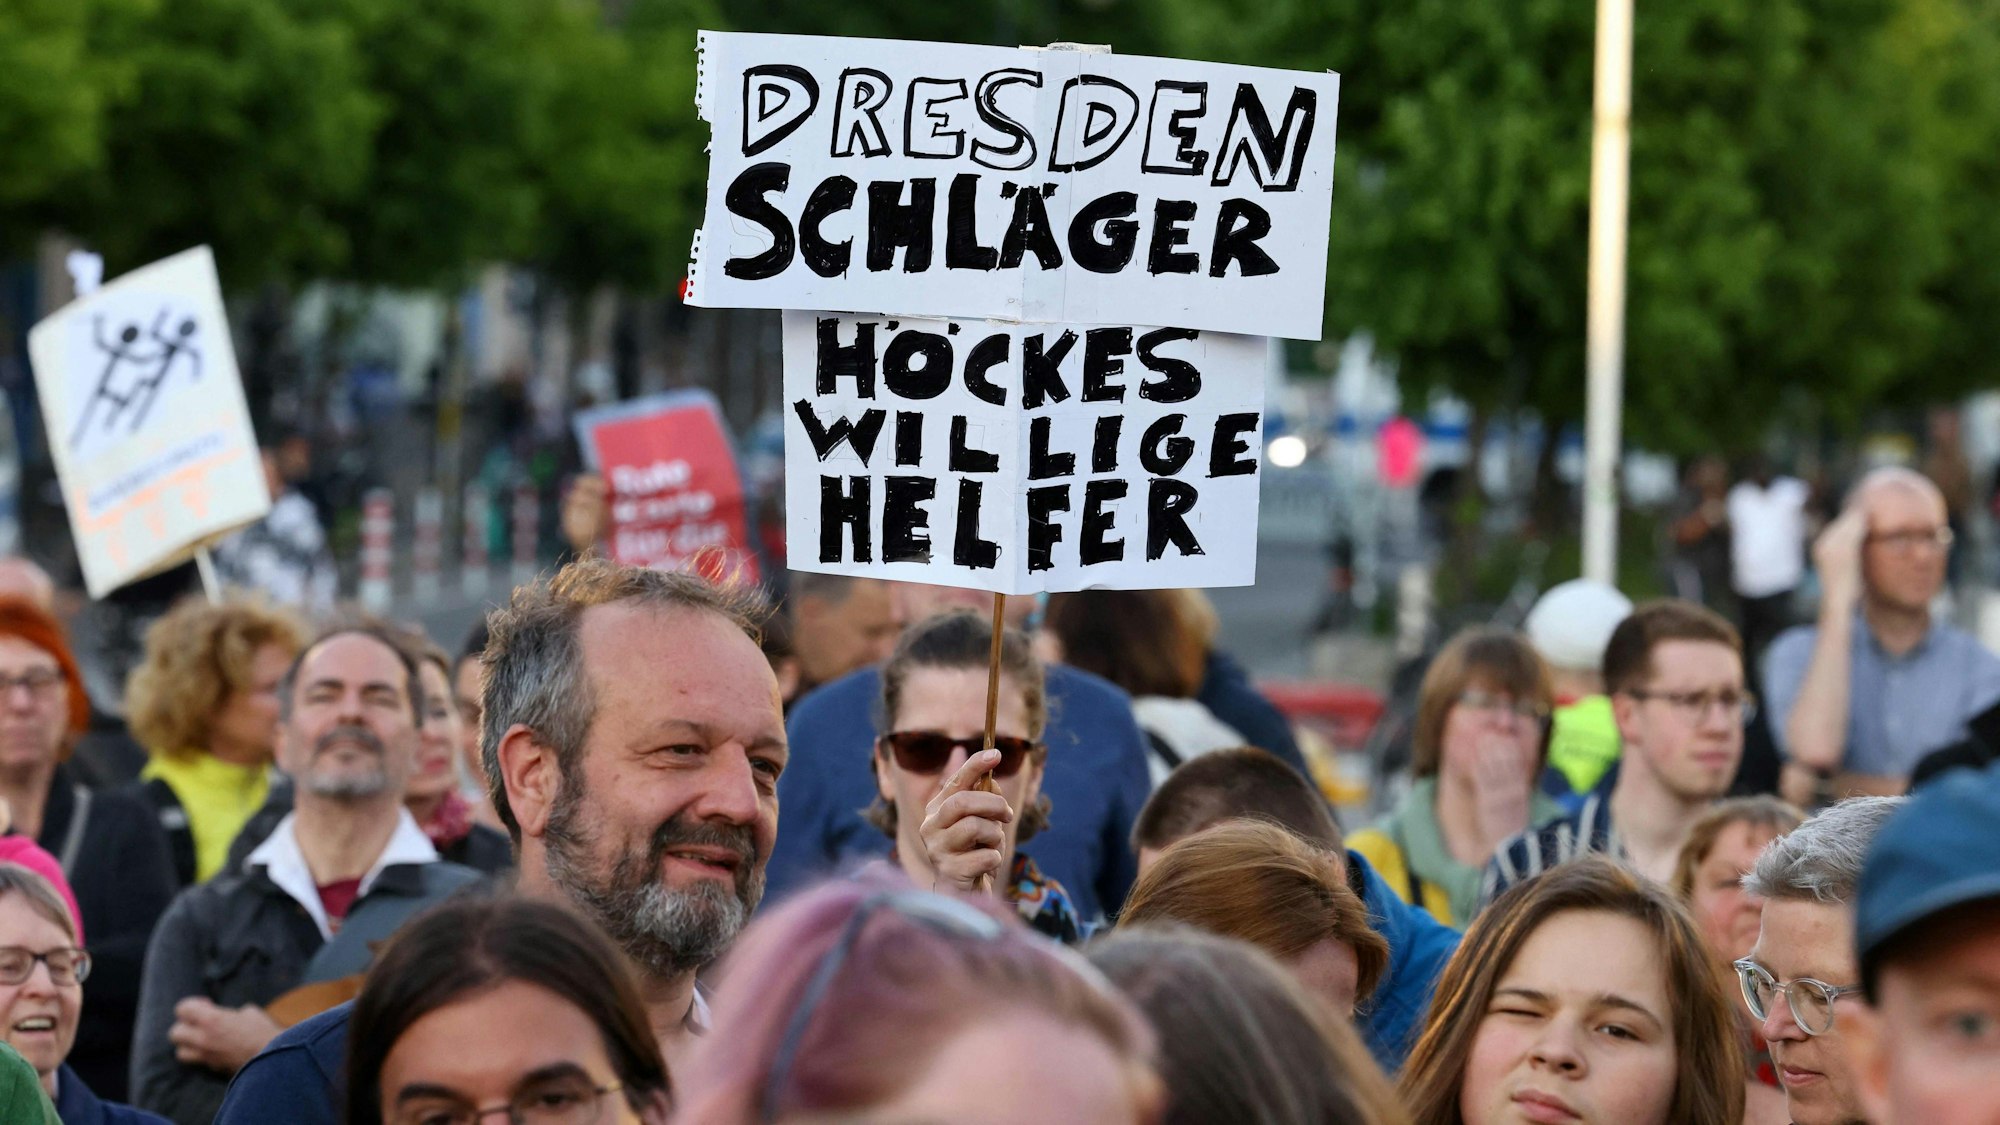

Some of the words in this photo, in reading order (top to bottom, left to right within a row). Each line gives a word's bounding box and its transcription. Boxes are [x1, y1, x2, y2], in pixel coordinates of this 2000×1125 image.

[743, 65, 1316, 191] DRESDEN
[725, 162, 1281, 279] SCHLÄGER
[816, 317, 1202, 407] HÖCKES
[794, 398, 1260, 479] WILLIGE
[819, 475, 1205, 573] HELFER
